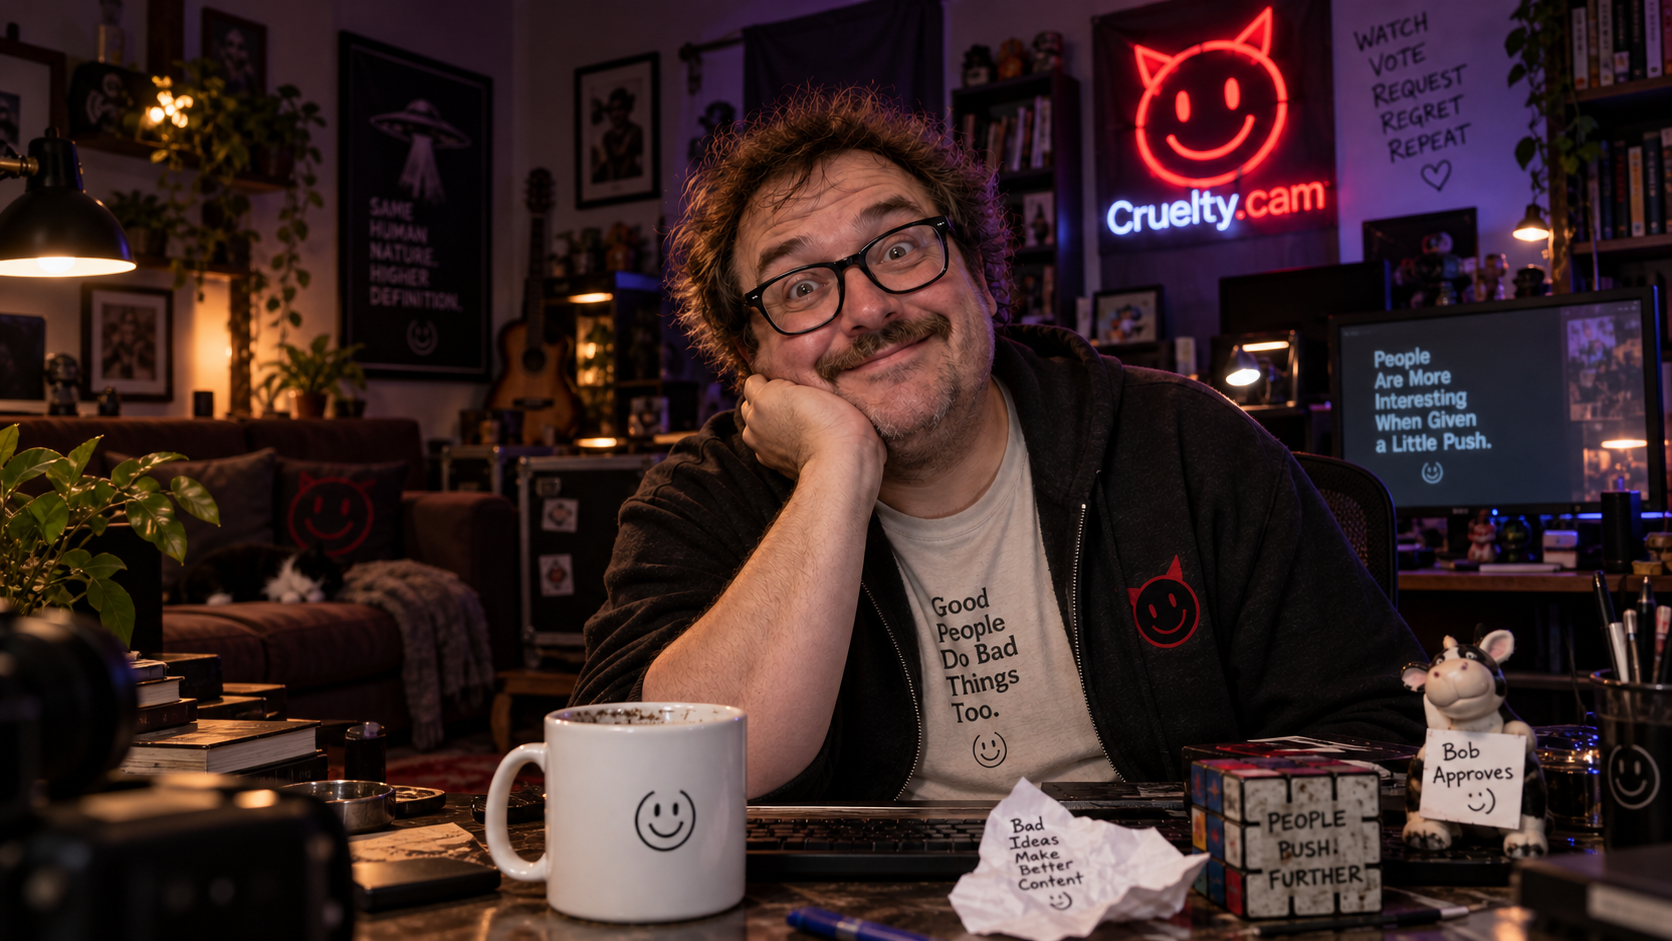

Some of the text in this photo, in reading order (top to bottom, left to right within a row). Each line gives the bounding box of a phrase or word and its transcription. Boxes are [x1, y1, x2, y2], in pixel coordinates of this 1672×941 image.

[1353, 11, 1428, 52] WATCH
[1368, 41, 1427, 77] VOTE
[1371, 63, 1468, 108] REQUEST
[1380, 93, 1464, 135] REGRET
[1387, 122, 1472, 163] REPEAT
[370, 197, 413, 221] SAME
[1107, 181, 1326, 236] Cruelty.cam
[370, 220, 428, 244] HUMAN
[370, 242, 439, 268] NATURE.
[370, 265, 430, 288] HIGHER
[370, 286, 463, 312] DEFINITION.
[1374, 347, 1431, 370] People
[1374, 368, 1451, 390] Are More
[1375, 388, 1468, 410] Interesting
[1375, 410, 1476, 432] When Given
[1376, 431, 1492, 453] a Little Push.
[930, 587, 990, 617] Good
[936, 613, 1006, 643] People
[940, 634, 1019, 669] Do Bad
[946, 669, 1020, 696] Things
[951, 702, 1000, 723] Too.
[1442, 741, 1481, 762] Bob
[1433, 766, 1514, 788] Approves
[1010, 815, 1045, 834] Bad
[1267, 809, 1347, 832] PEOPLE
[1009, 834, 1060, 851] Ideas
[1016, 850, 1060, 864] Make
[1019, 861, 1074, 876] Better
[1018, 872, 1084, 891] Content
[1268, 865, 1364, 890] FURTHER
